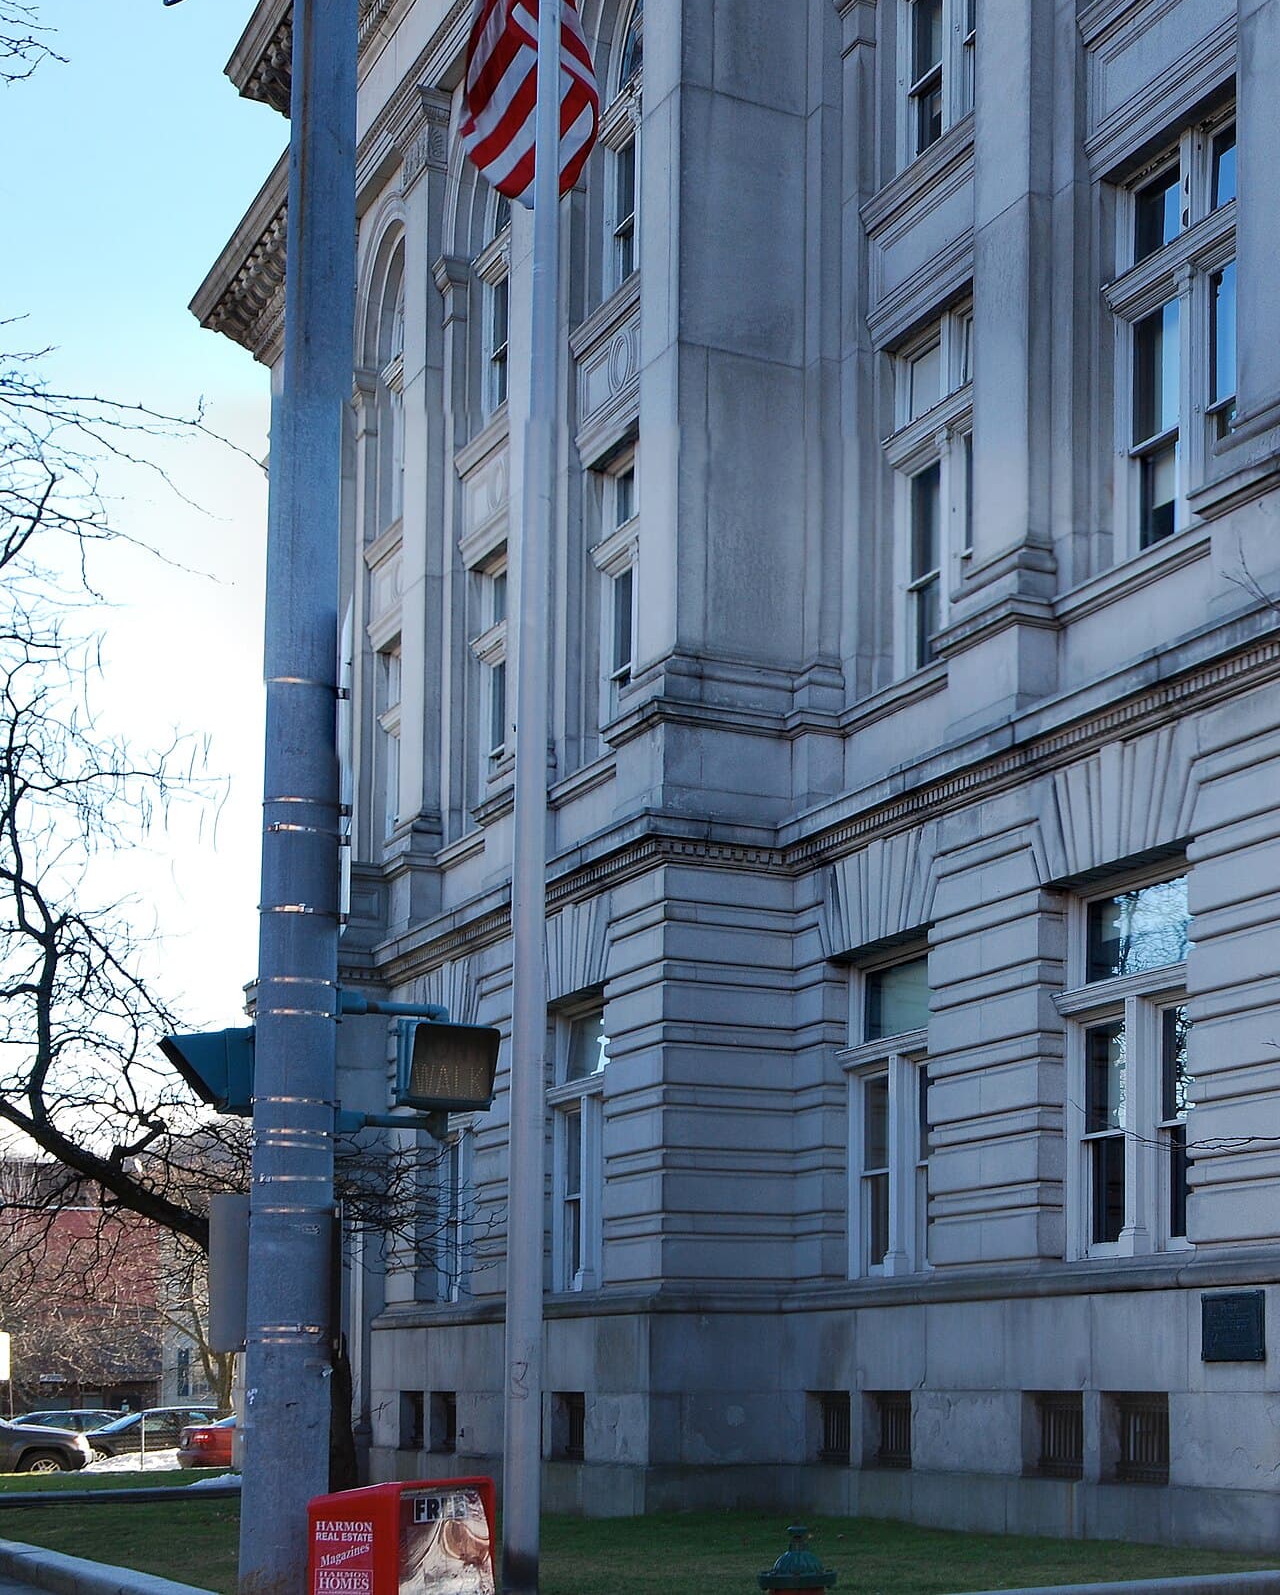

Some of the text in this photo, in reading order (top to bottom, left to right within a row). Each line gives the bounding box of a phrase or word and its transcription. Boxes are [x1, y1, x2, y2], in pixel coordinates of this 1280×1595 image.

[414, 1063, 487, 1099] WALK
[316, 1521, 373, 1532] HARMON
[316, 1532, 374, 1542] REAL ESTATE
[320, 1544, 370, 1568] Magazines
[319, 1577, 369, 1590] HOMES
